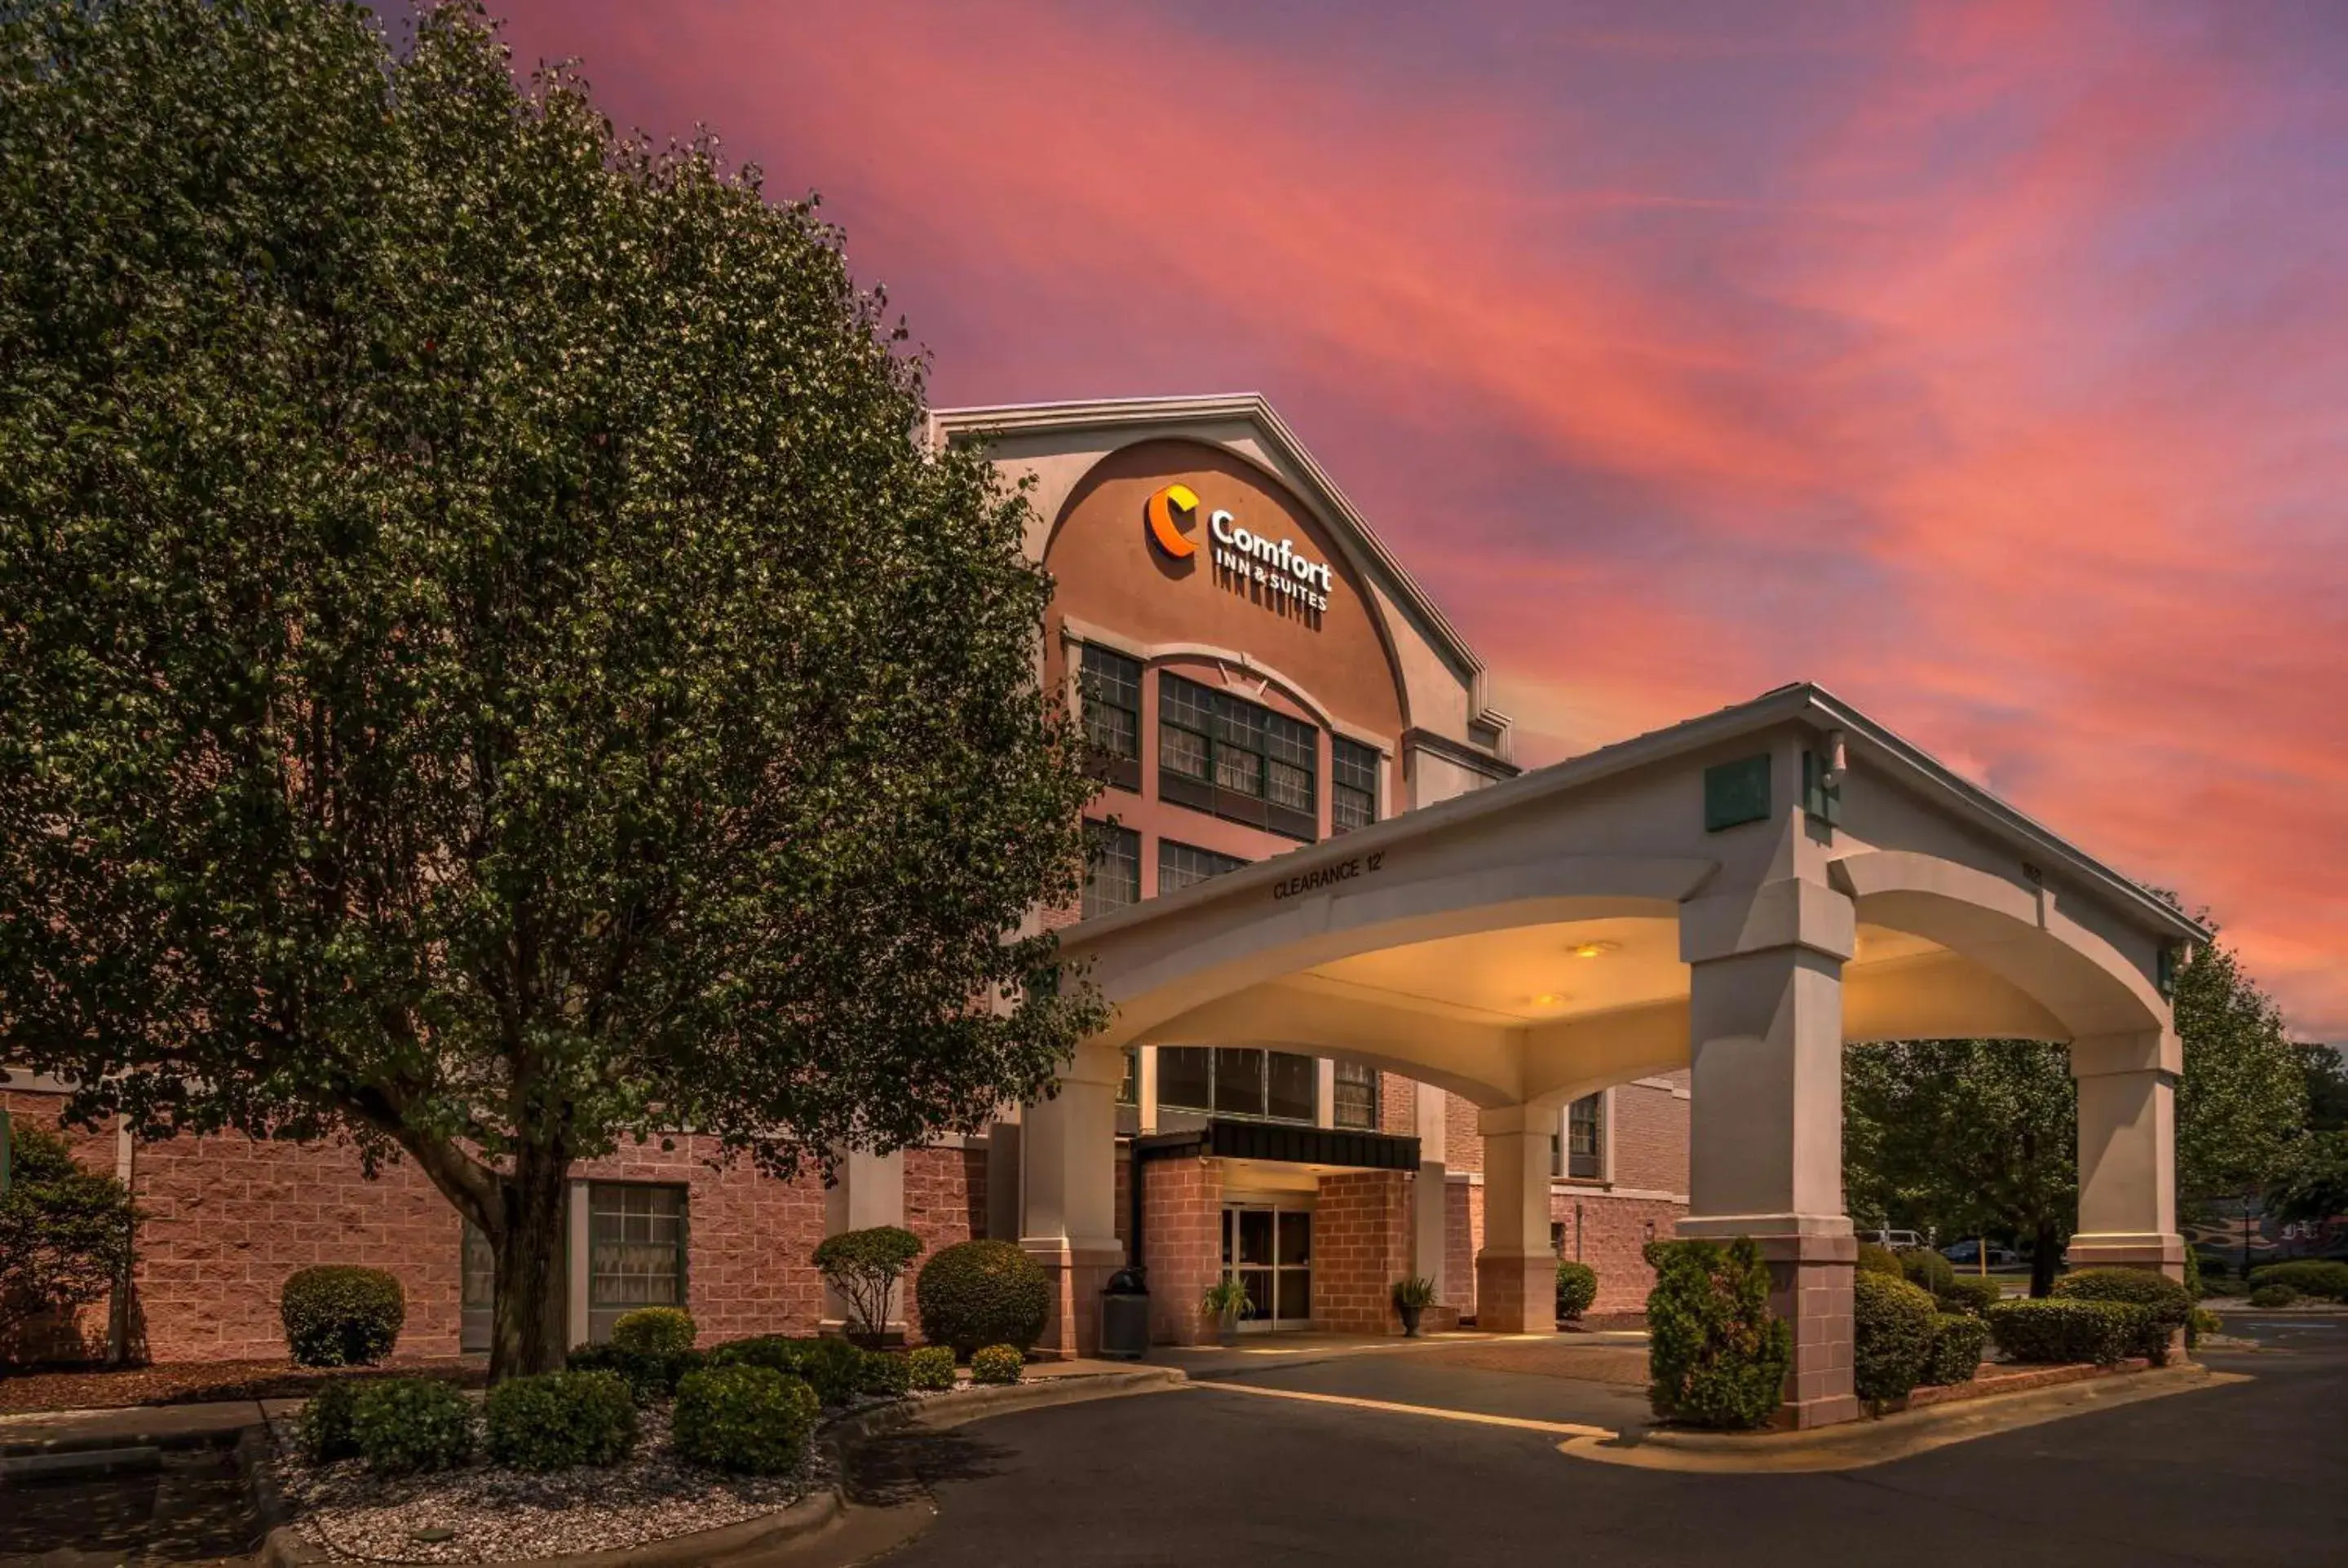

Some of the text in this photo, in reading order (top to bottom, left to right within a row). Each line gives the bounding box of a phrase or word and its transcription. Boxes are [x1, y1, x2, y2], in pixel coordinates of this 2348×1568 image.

[1211, 510, 1333, 592] Comfort
[1217, 548, 1328, 612] INN & SUITES
[1273, 859, 1360, 900] CLEARANCE
